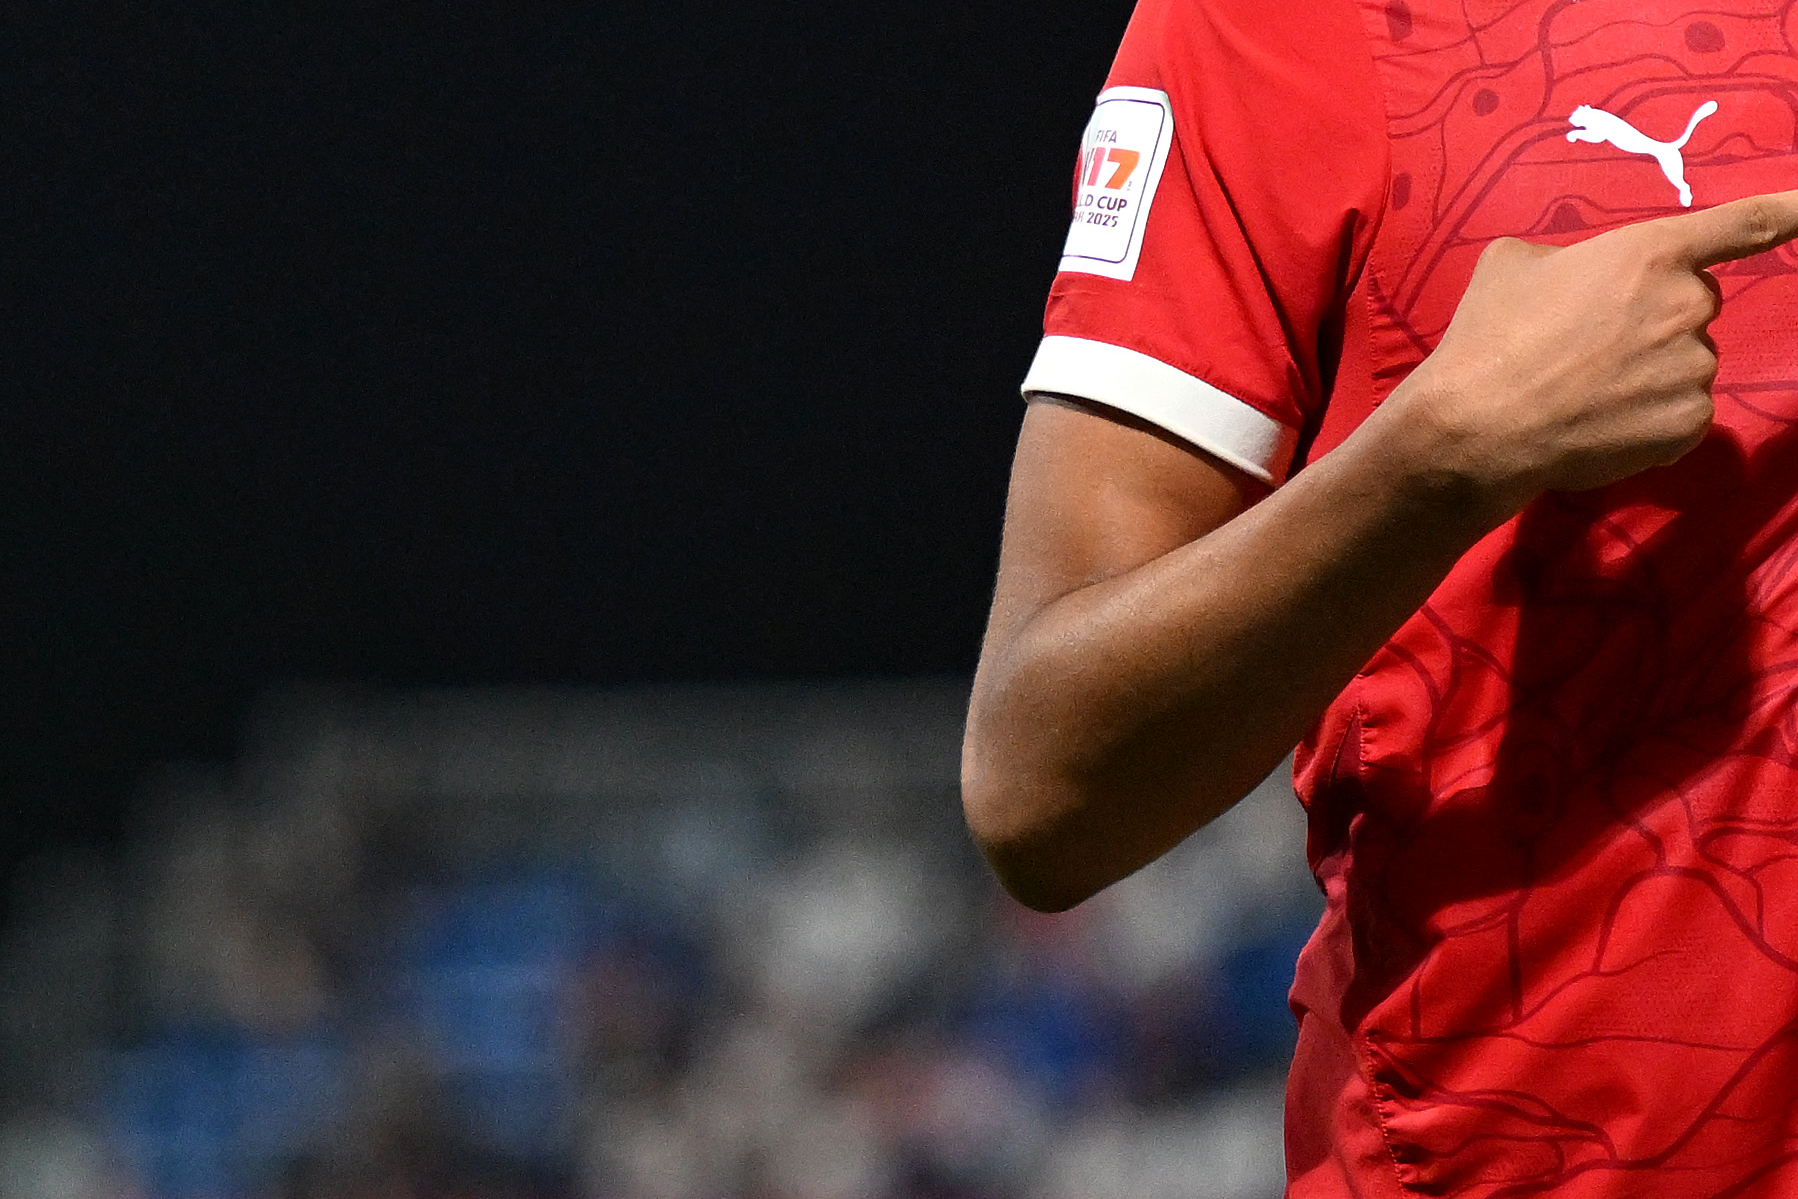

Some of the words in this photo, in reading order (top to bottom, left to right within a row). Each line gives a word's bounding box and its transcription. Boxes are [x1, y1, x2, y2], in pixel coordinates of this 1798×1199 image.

[1095, 129, 1118, 144] FIFA
[1096, 195, 1128, 212] CUP
[1086, 211, 1119, 228] 2025
